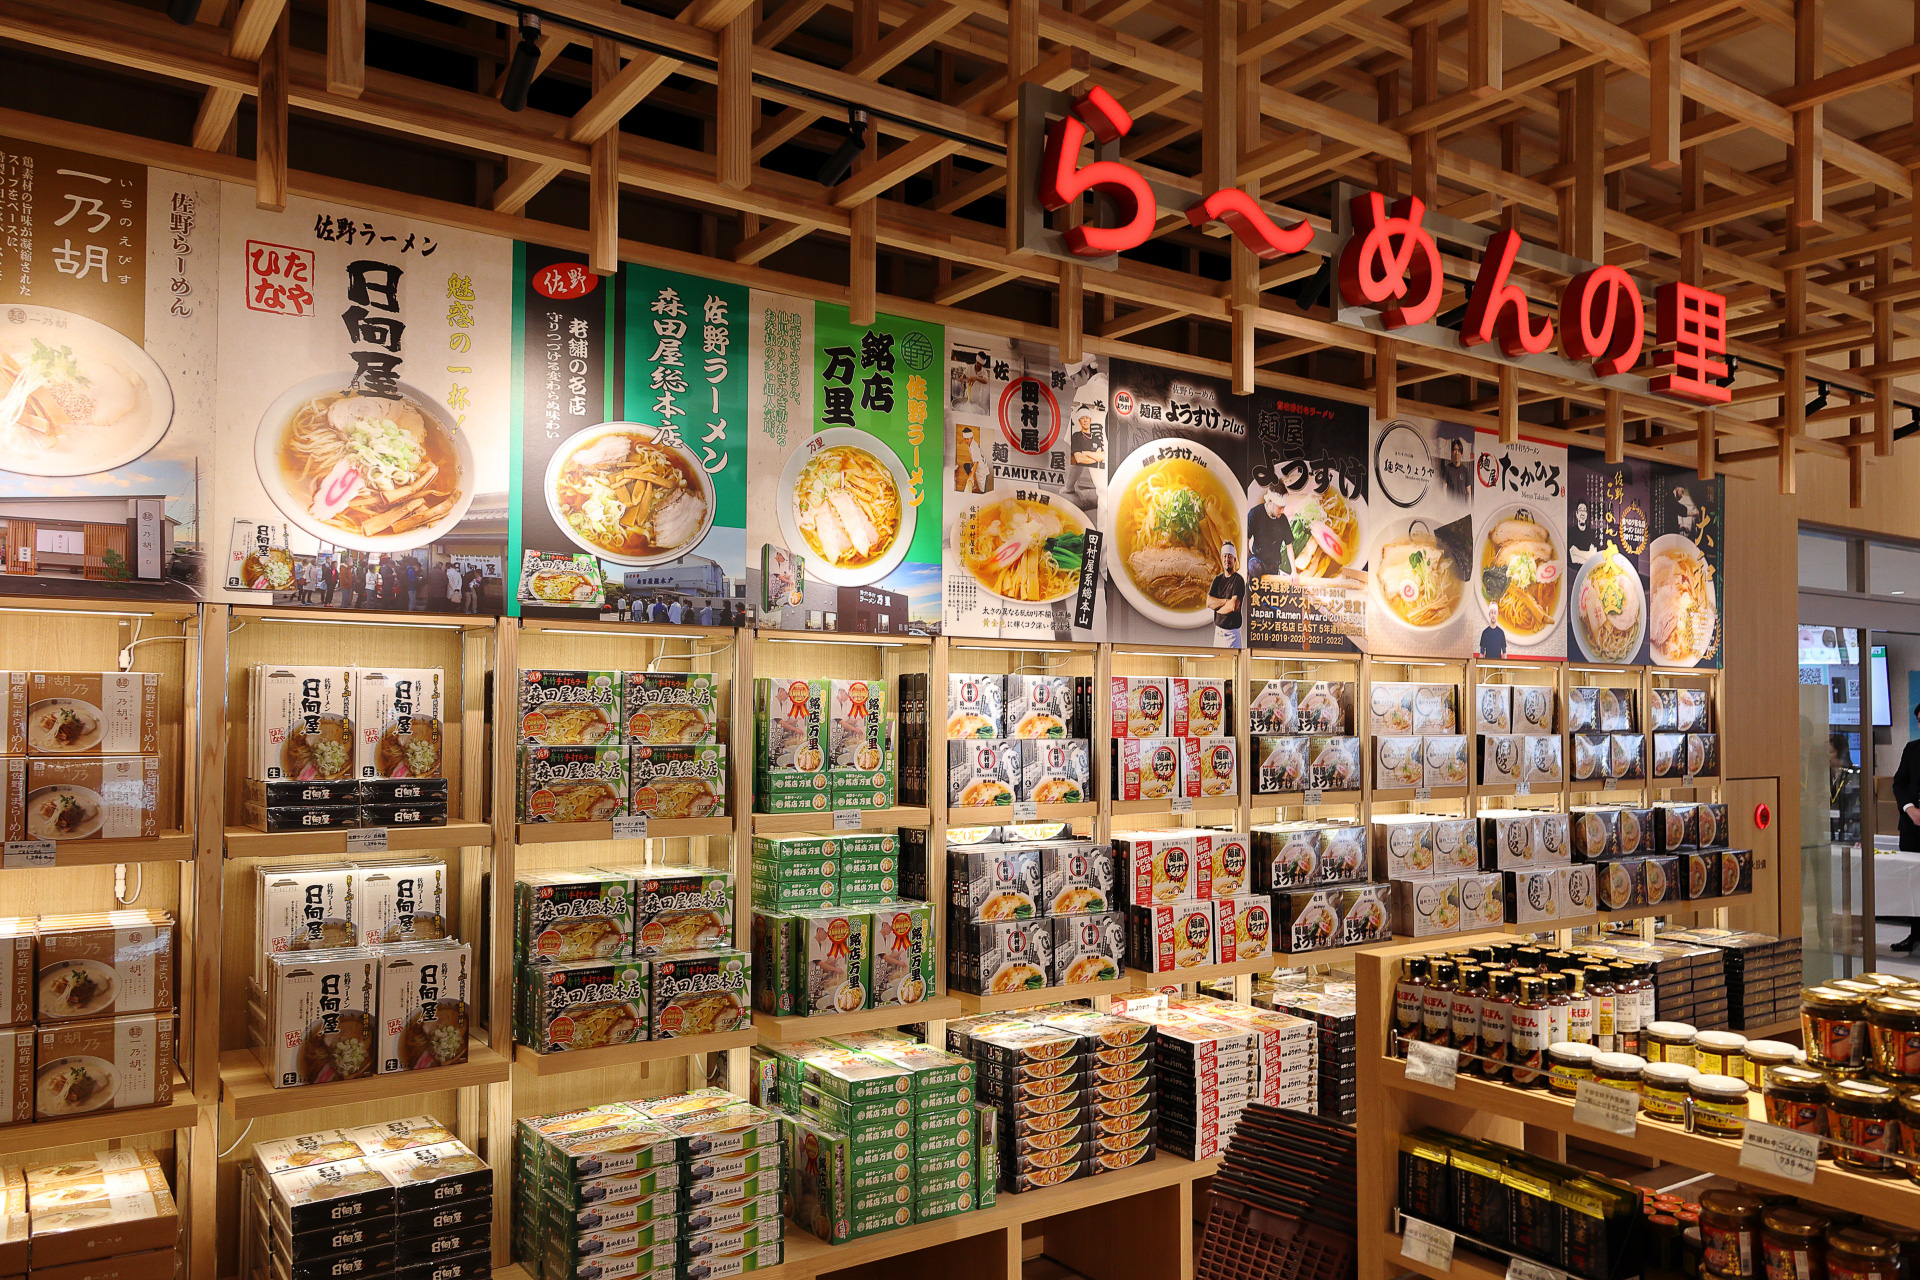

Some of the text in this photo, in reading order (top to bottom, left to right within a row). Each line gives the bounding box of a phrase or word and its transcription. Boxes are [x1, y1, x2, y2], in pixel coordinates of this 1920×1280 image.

[52, 168, 112, 283] 一乃胡
[118, 179, 134, 285] いちのえびす
[314, 213, 438, 257] 佐野ラーメン
[170, 192, 195, 317] 佐野らーめん
[543, 268, 588, 294] 佐野
[340, 260, 406, 400] 日向屋
[545, 312, 563, 439] 守りつづける変わらぬ味わい
[568, 317, 589, 416] 老舗の名店
[647, 287, 689, 449] 森田屋総本店
[701, 294, 730, 474] 佐野ラーメン
[822, 346, 857, 428] 万里
[860, 330, 896, 414] 銘店
[993, 360, 1067, 391] 佐 野
[906, 374, 928, 507] 佐野ラーメン
[1020, 380, 1040, 452] 田村屋
[1140, 402, 1162, 420] 麺屋
[1165, 400, 1221, 430] ようすけ
[1258, 409, 1304, 446] 麺屋
[806, 436, 826, 455] 万里
[992, 442, 1066, 470] 麺 屋
[1252, 440, 1367, 501] ようすけ
[993, 465, 1065, 485] TAMURAYA
[1499, 452, 1561, 498] たかひろ
[1078, 534, 1100, 626] 田村屋系総本山
[1251, 577, 1291, 594] 3年連続
[1251, 608, 1274, 619] Japan
[1276, 609, 1301, 621] Ramen
[1303, 611, 1328, 622] Award
[1251, 621, 1295, 632] ラーメン百名店
[1297, 624, 1317, 633] EAST
[301, 678, 322, 735] 日向屋
[393, 681, 412, 735] 日向屋
[528, 686, 613, 703] 森田屋総本店
[631, 688, 711, 705] 森田屋総本店
[808, 698, 821, 751] 銘店万里
[867, 699, 880, 750] 銘店万里
[268, 767, 281, 778] 生
[536, 761, 622, 780] 森田屋総本店
[639, 761, 719, 780] 森田屋総本店
[303, 885, 324, 941] 日向屋
[396, 879, 415, 935] 日向屋
[539, 897, 627, 920] 森田屋総本店
[645, 892, 726, 912] 森田屋総本店
[849, 932, 862, 990] 銘店万里
[911, 926, 923, 982] 銘店万里
[318, 974, 341, 1035] 日向屋
[417, 964, 439, 1023] 日向屋
[552, 981, 641, 1008] 森田屋総本店
[662, 972, 744, 996] 森田屋総本店
[283, 1072, 297, 1085] 生
[386, 1059, 398, 1072] 生
